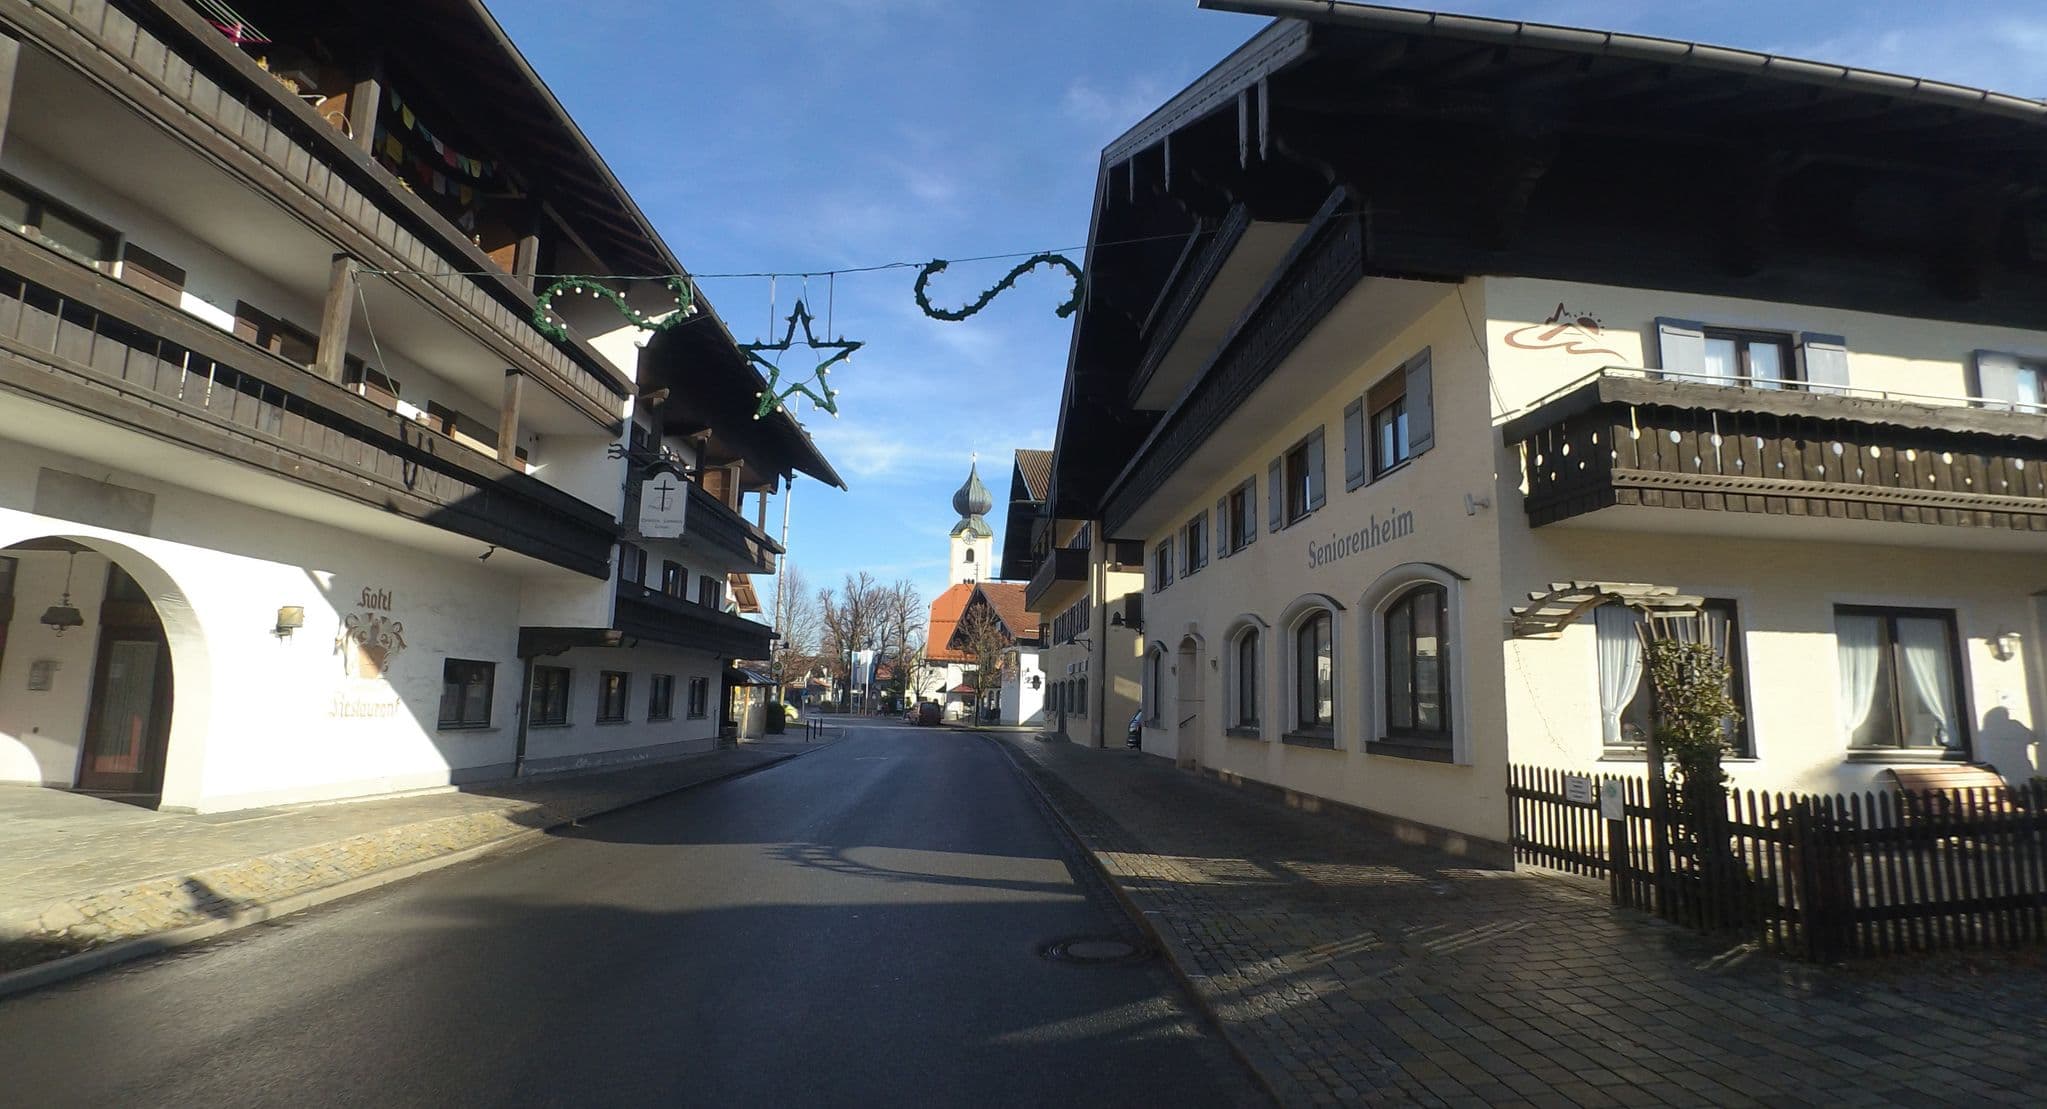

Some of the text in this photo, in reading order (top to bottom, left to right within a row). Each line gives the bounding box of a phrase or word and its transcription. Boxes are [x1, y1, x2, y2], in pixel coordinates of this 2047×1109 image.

[1308, 508, 1415, 569] Seniorenheim
[357, 586, 393, 611] Hotel
[328, 691, 401, 718] Restaurant
